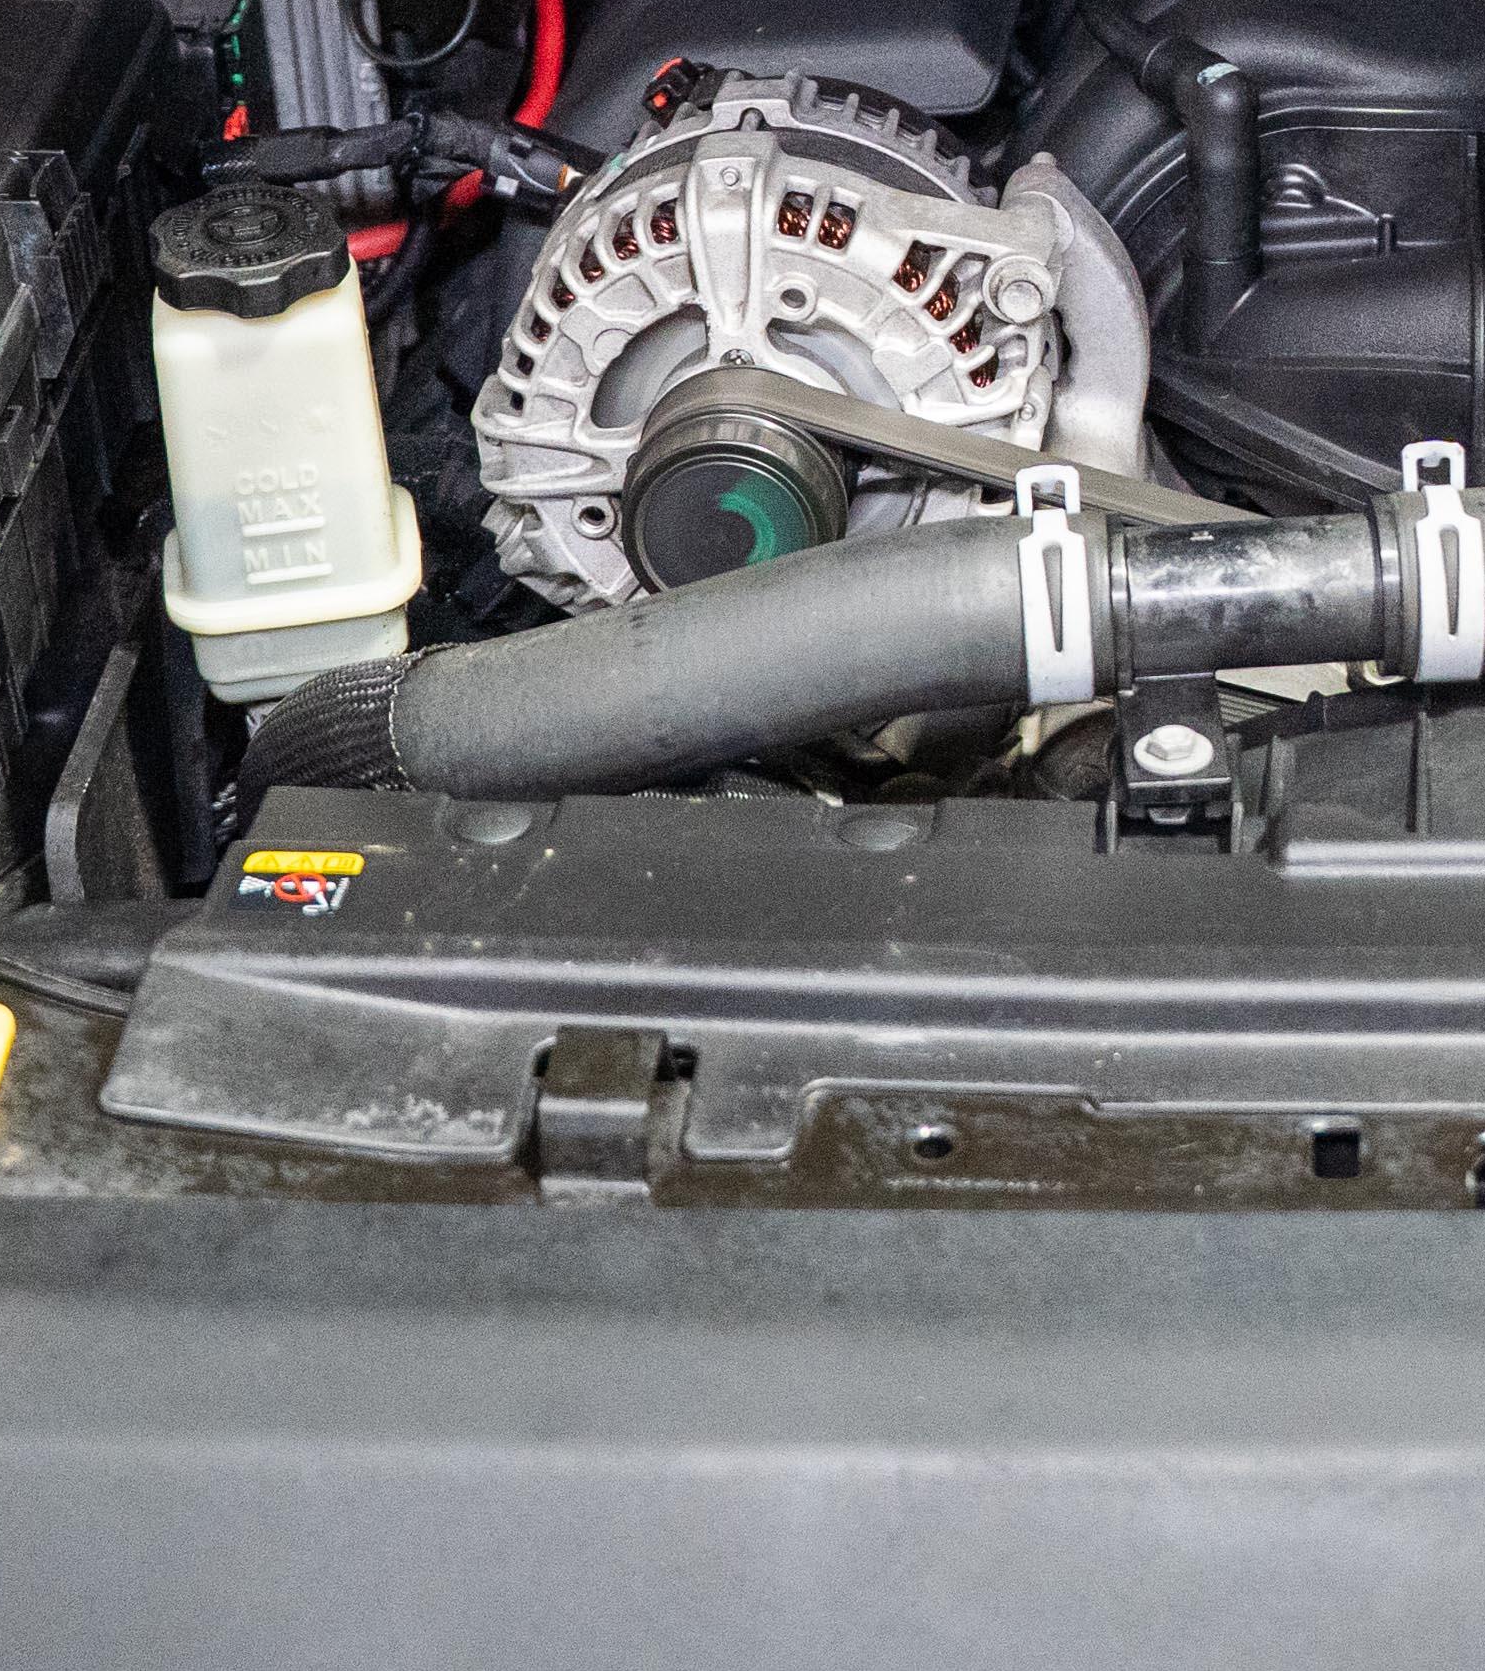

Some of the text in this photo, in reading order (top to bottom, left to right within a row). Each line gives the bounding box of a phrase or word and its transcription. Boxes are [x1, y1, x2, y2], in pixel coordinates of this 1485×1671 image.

[235, 463, 319, 495] COLD
[237, 491, 322, 524] MAX
[243, 539, 326, 572] MIN
